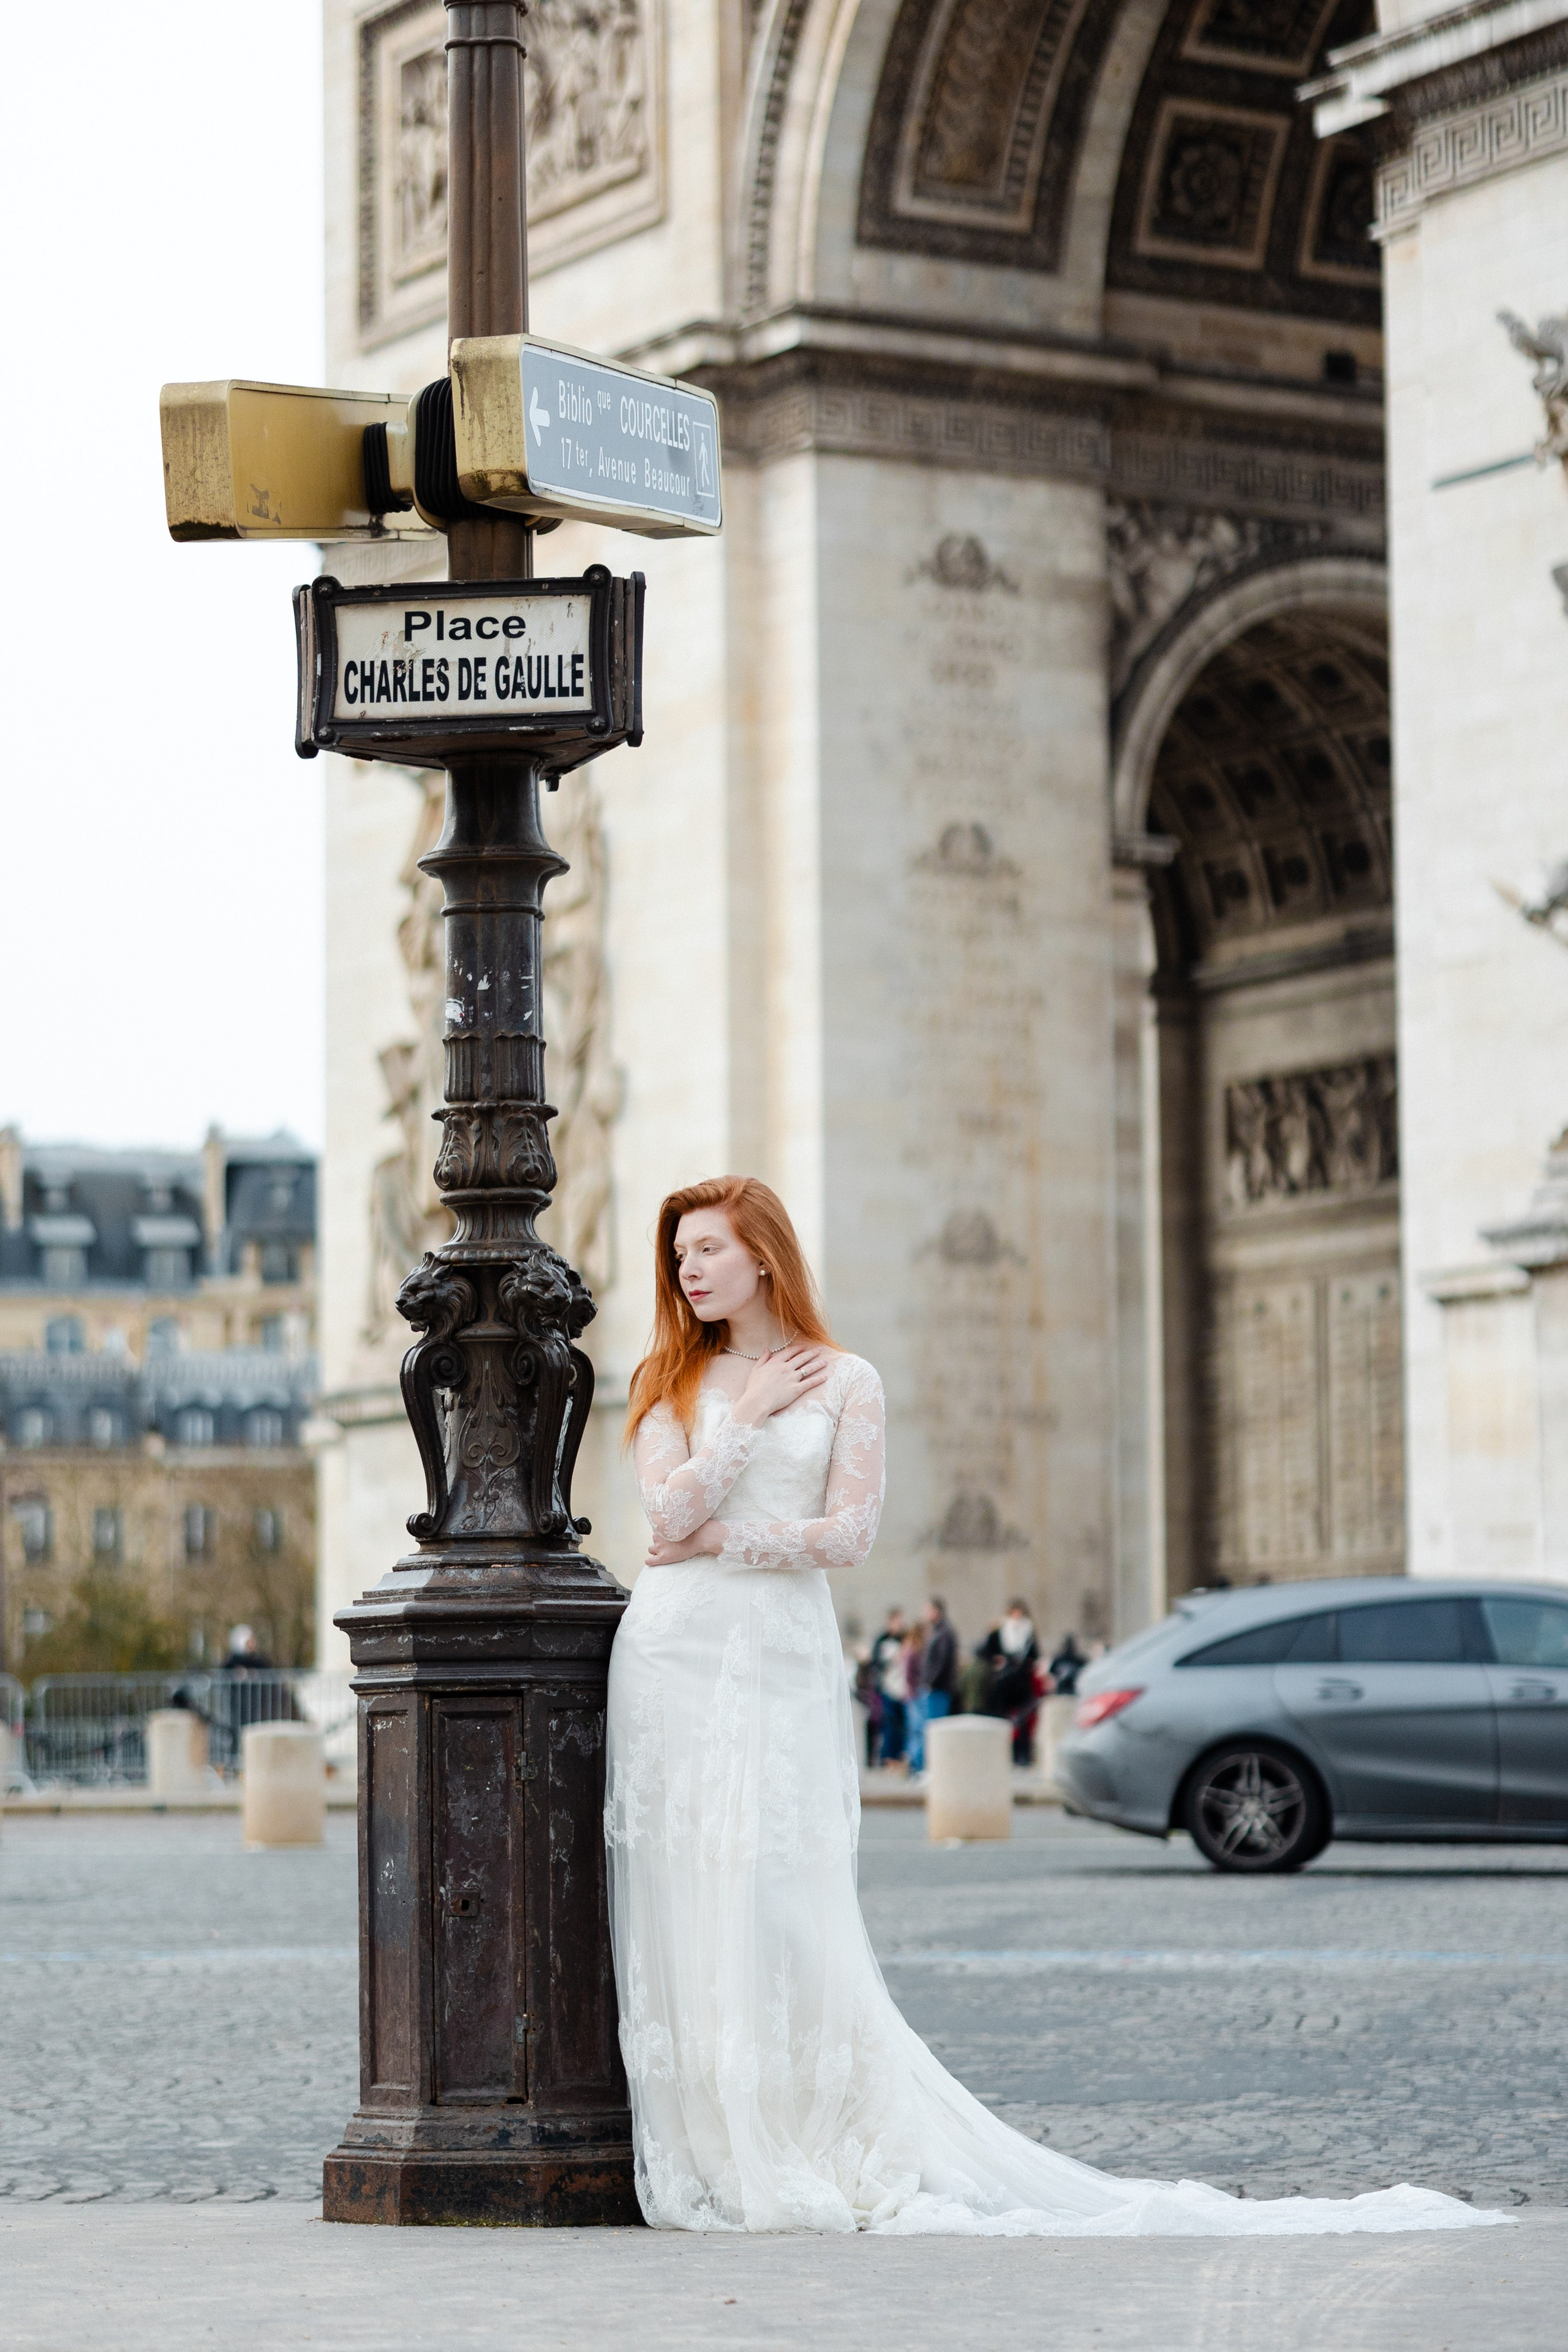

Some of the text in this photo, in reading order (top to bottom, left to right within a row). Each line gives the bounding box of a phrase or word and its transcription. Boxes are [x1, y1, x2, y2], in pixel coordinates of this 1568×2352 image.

[558, 379, 690, 451] Biblio que COURCELLES
[560, 437, 572, 470] 17
[598, 446, 636, 485] Avenue
[644, 458, 690, 497] Beaucour
[404, 610, 526, 642] Place
[344, 654, 585, 704] CHARLES DE GAULLE
